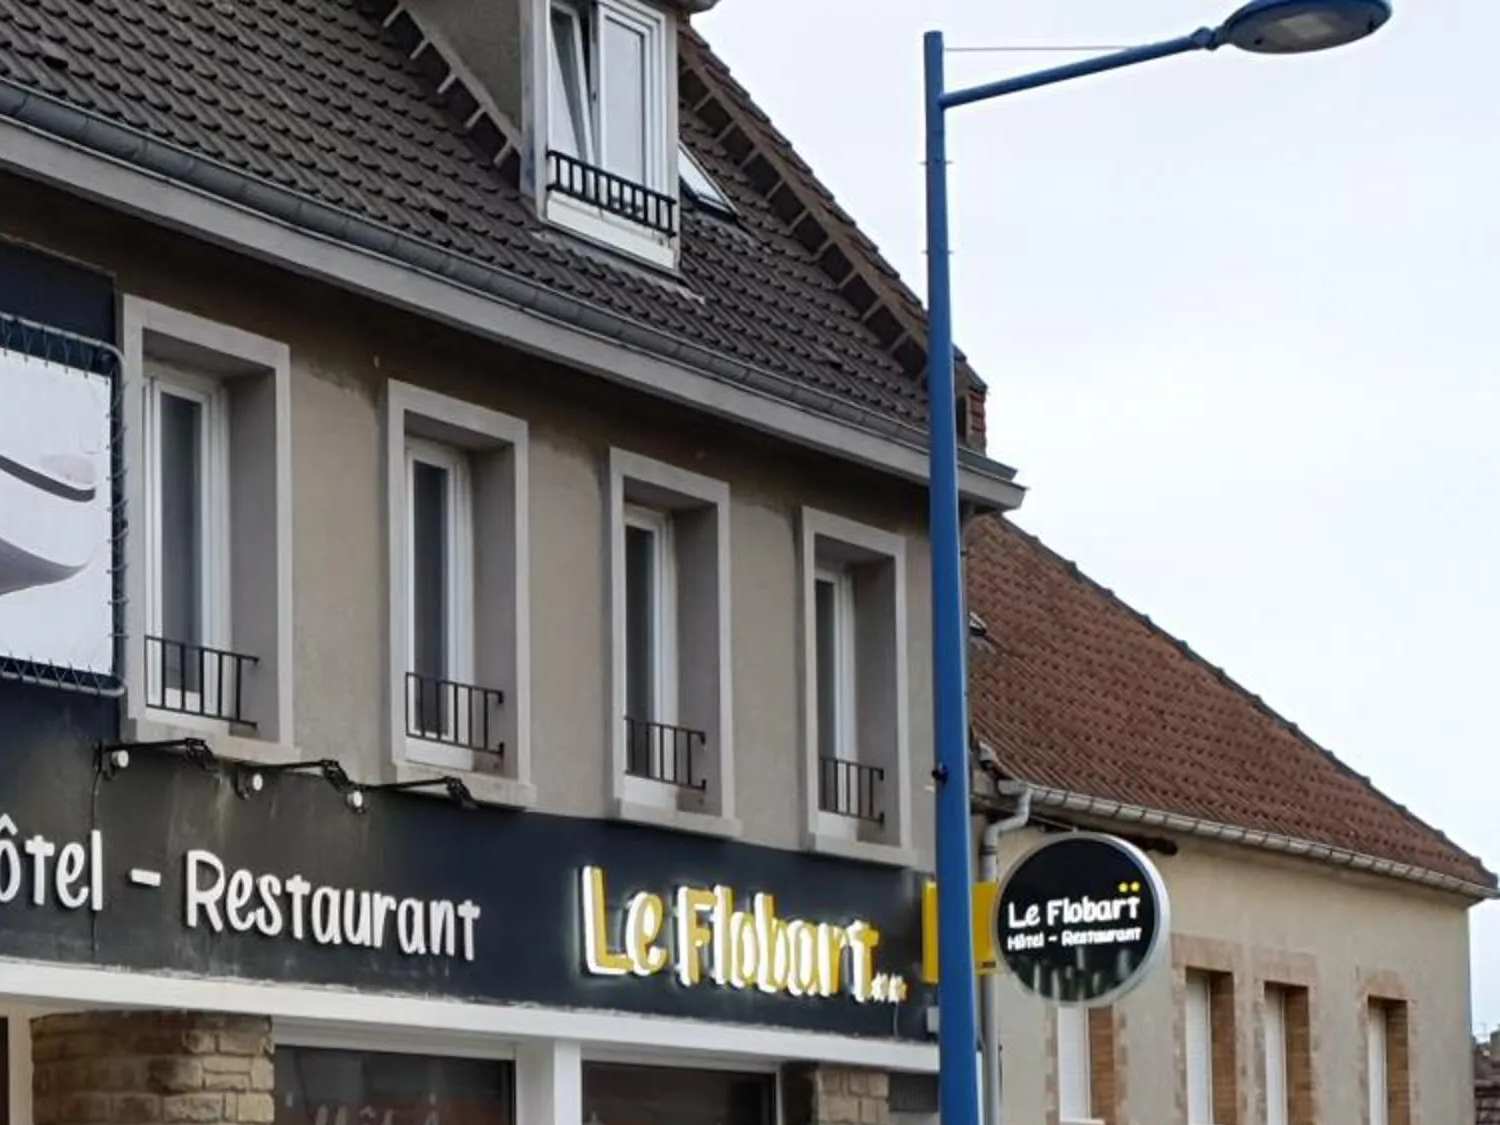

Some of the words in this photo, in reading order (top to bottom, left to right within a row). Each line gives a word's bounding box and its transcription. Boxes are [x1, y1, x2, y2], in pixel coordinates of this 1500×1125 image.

[186, 849, 482, 962] Restaurant
[581, 865, 668, 976] Le
[676, 883, 881, 1003] Flobart
[1007, 902, 1041, 929] Le
[1046, 896, 1142, 926] Flobart
[1061, 927, 1142, 947] Restaurant
